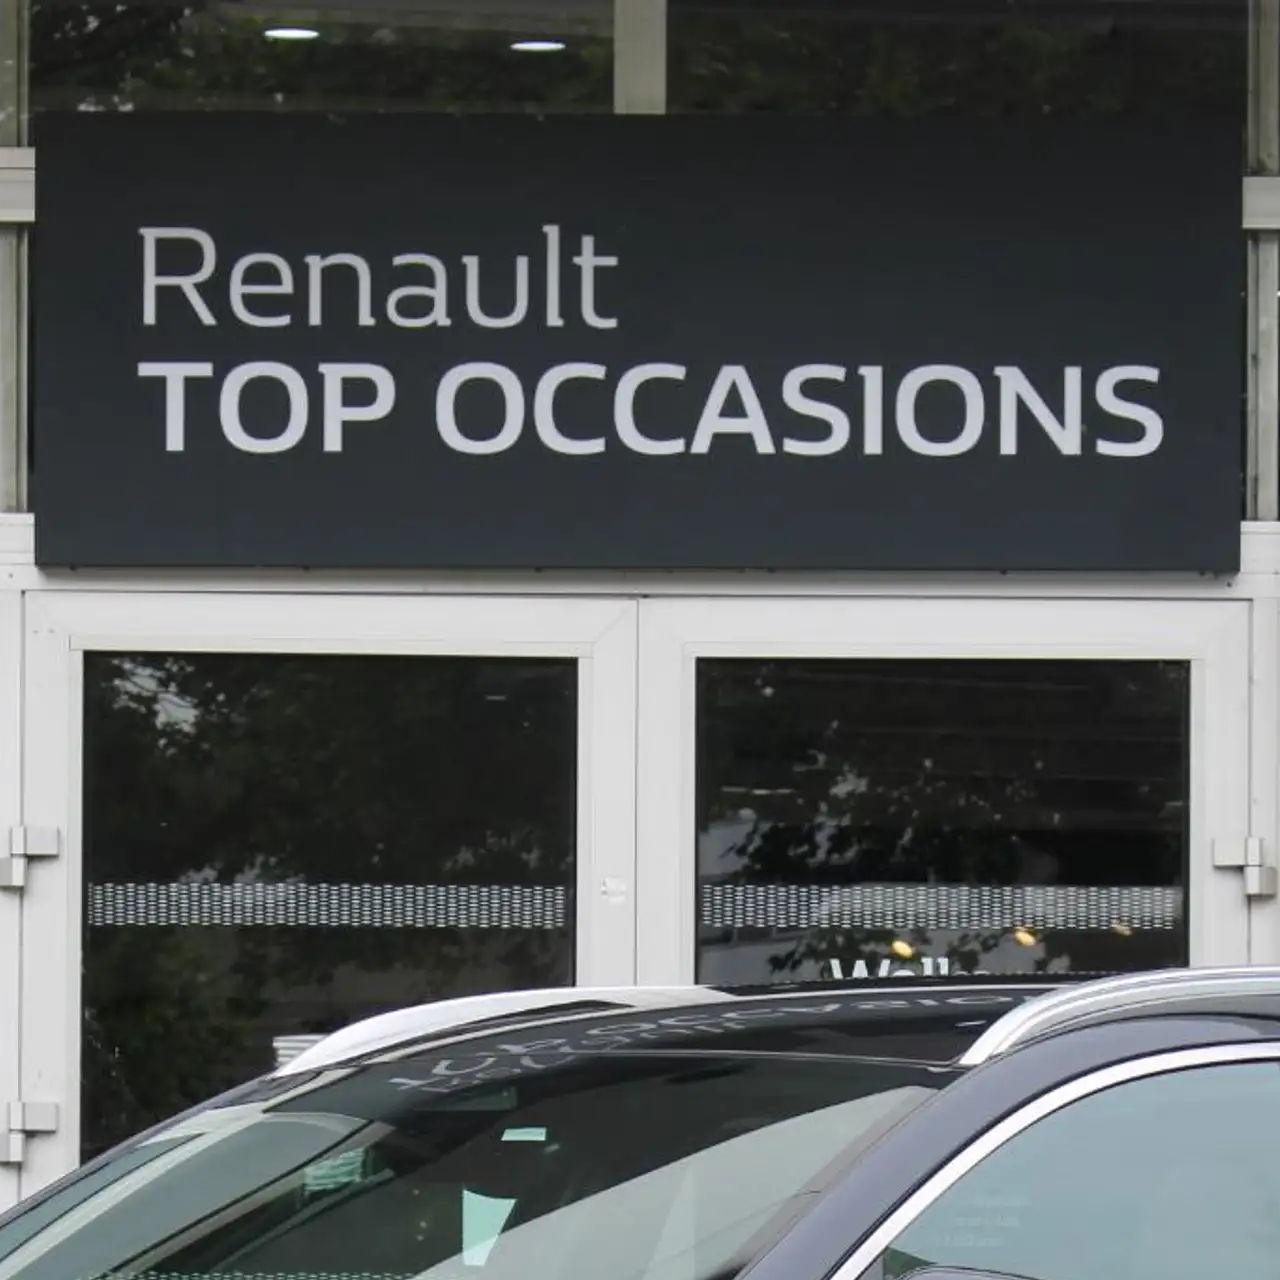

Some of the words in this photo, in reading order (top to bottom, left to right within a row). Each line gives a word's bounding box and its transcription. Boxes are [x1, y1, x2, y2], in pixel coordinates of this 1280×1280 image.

[138, 224, 619, 329] Renault
[137, 361, 396, 453] TOP
[435, 361, 1165, 457] OCCASIONS
